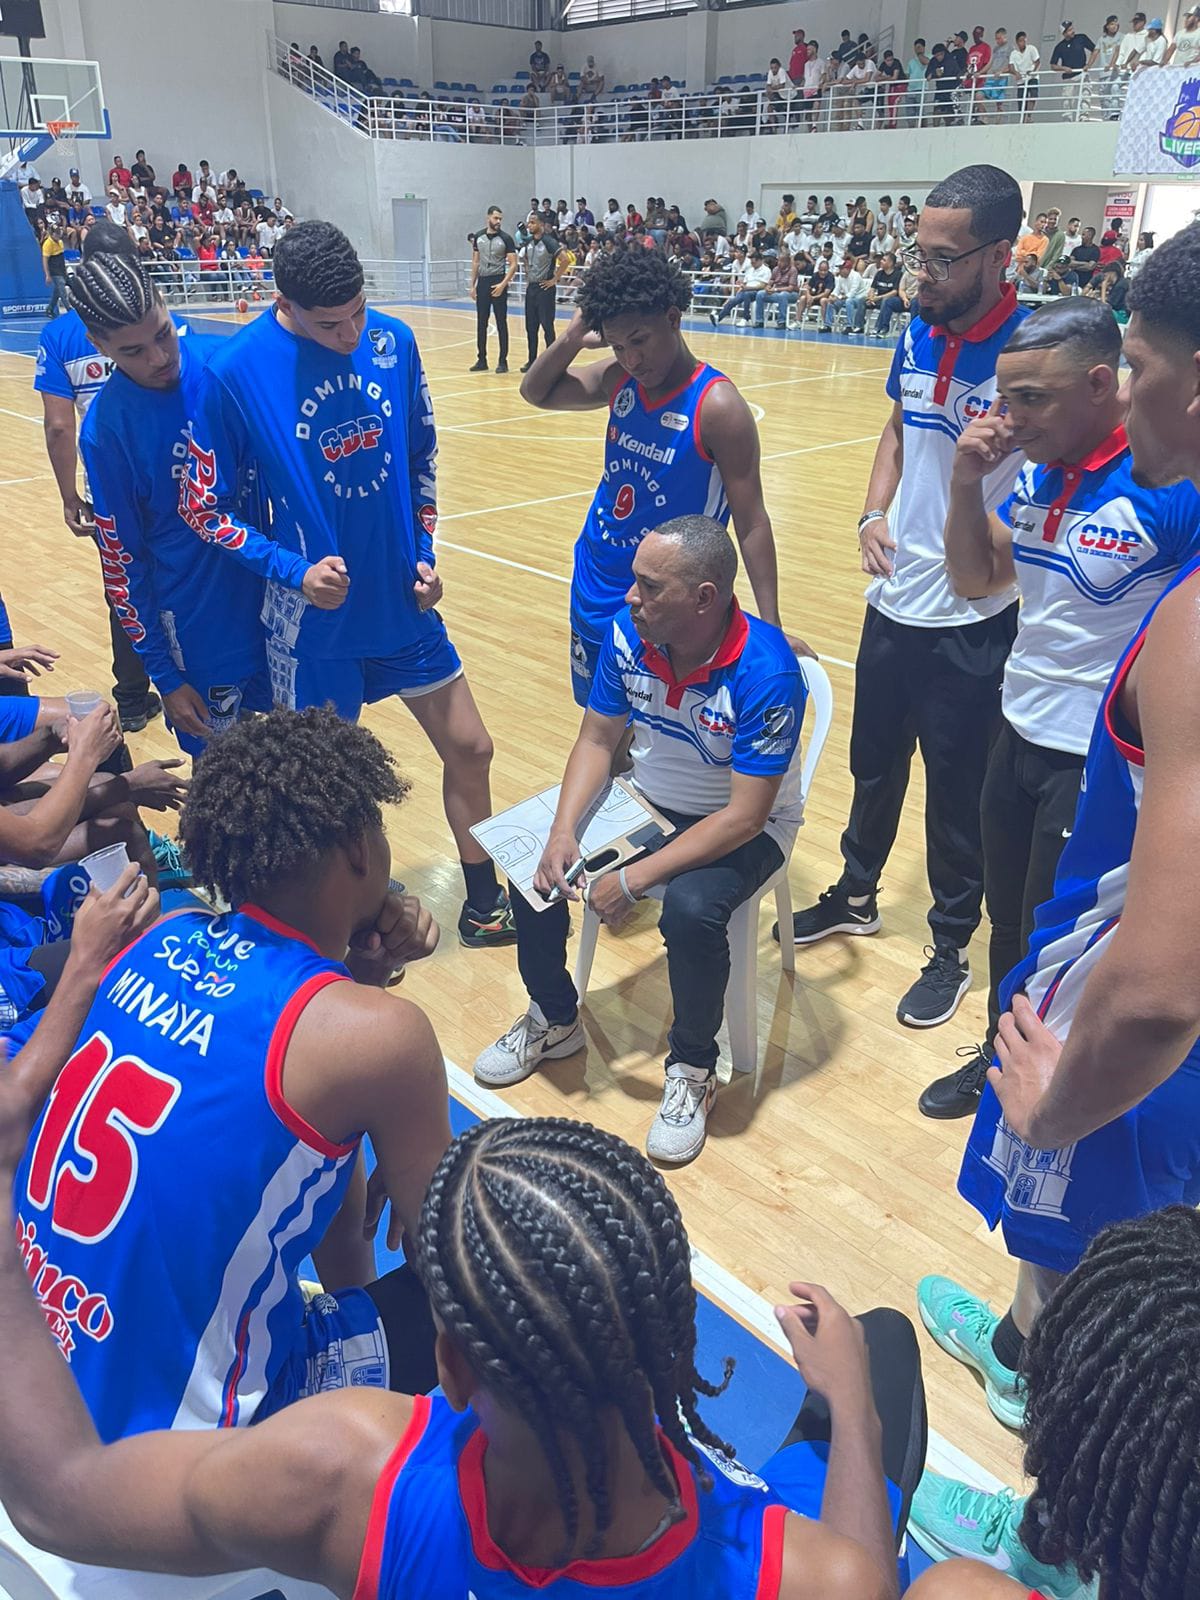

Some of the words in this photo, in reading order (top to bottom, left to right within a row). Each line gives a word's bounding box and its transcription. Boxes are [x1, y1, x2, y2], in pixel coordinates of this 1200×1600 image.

[296, 373, 393, 440] DOMINGO
[318, 414, 384, 463] CDP
[617, 431, 677, 466] Kendall
[603, 458, 667, 508] DOMINGO
[612, 483, 636, 521] 9
[1079, 523, 1143, 554] CDP
[107, 967, 215, 1057] MINAYA
[27, 1030, 182, 1245] 15
